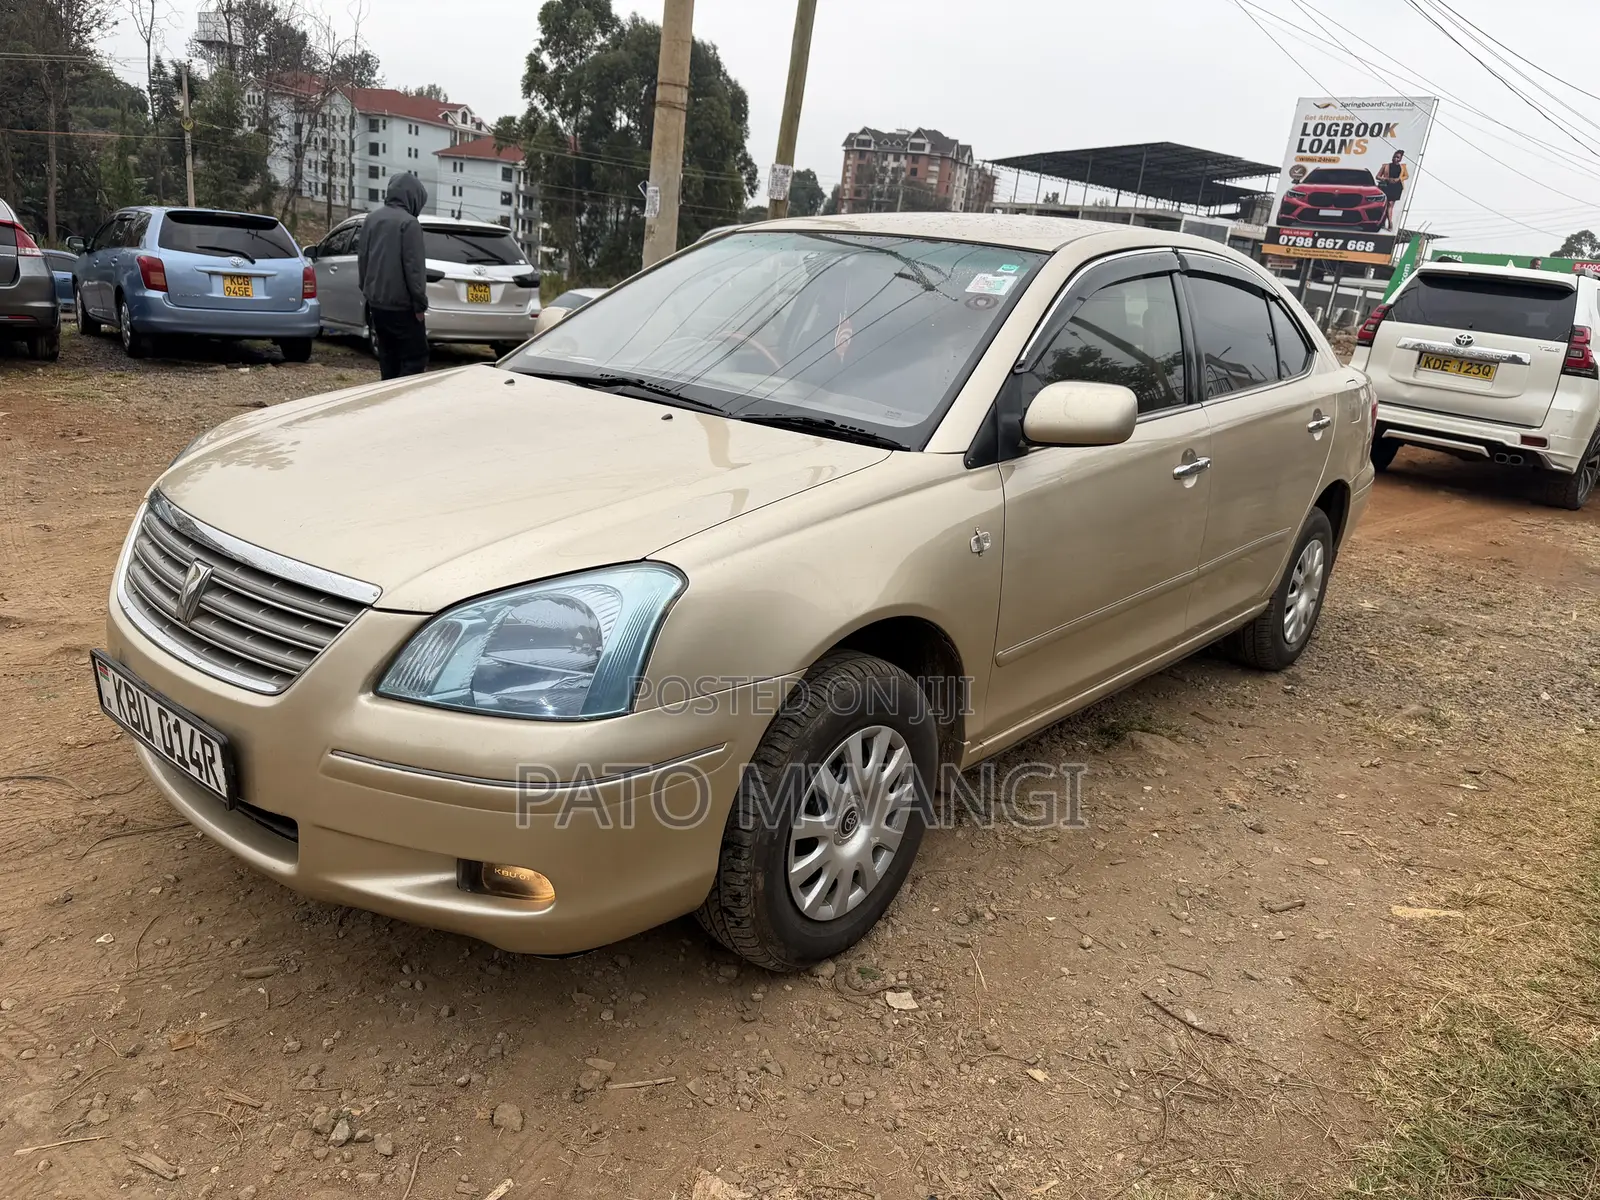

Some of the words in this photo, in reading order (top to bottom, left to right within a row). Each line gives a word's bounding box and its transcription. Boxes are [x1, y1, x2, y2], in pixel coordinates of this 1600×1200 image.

[1300, 122, 1399, 138] LOGBOOK
[1296, 138, 1369, 155] LOANS
[1278, 234, 1313, 248] 0798
[1316, 237, 1344, 250] 667
[1346, 240, 1375, 253] 668
[230, 275, 250, 286] KCG
[225, 286, 251, 297] 945E
[470, 293, 489, 303] 386U
[1423, 356, 1452, 371] KDE
[1457, 360, 1492, 377] 123Q
[111, 672, 155, 746] KBU
[157, 706, 222, 792] 014R
[494, 868, 517, 879] KBU
